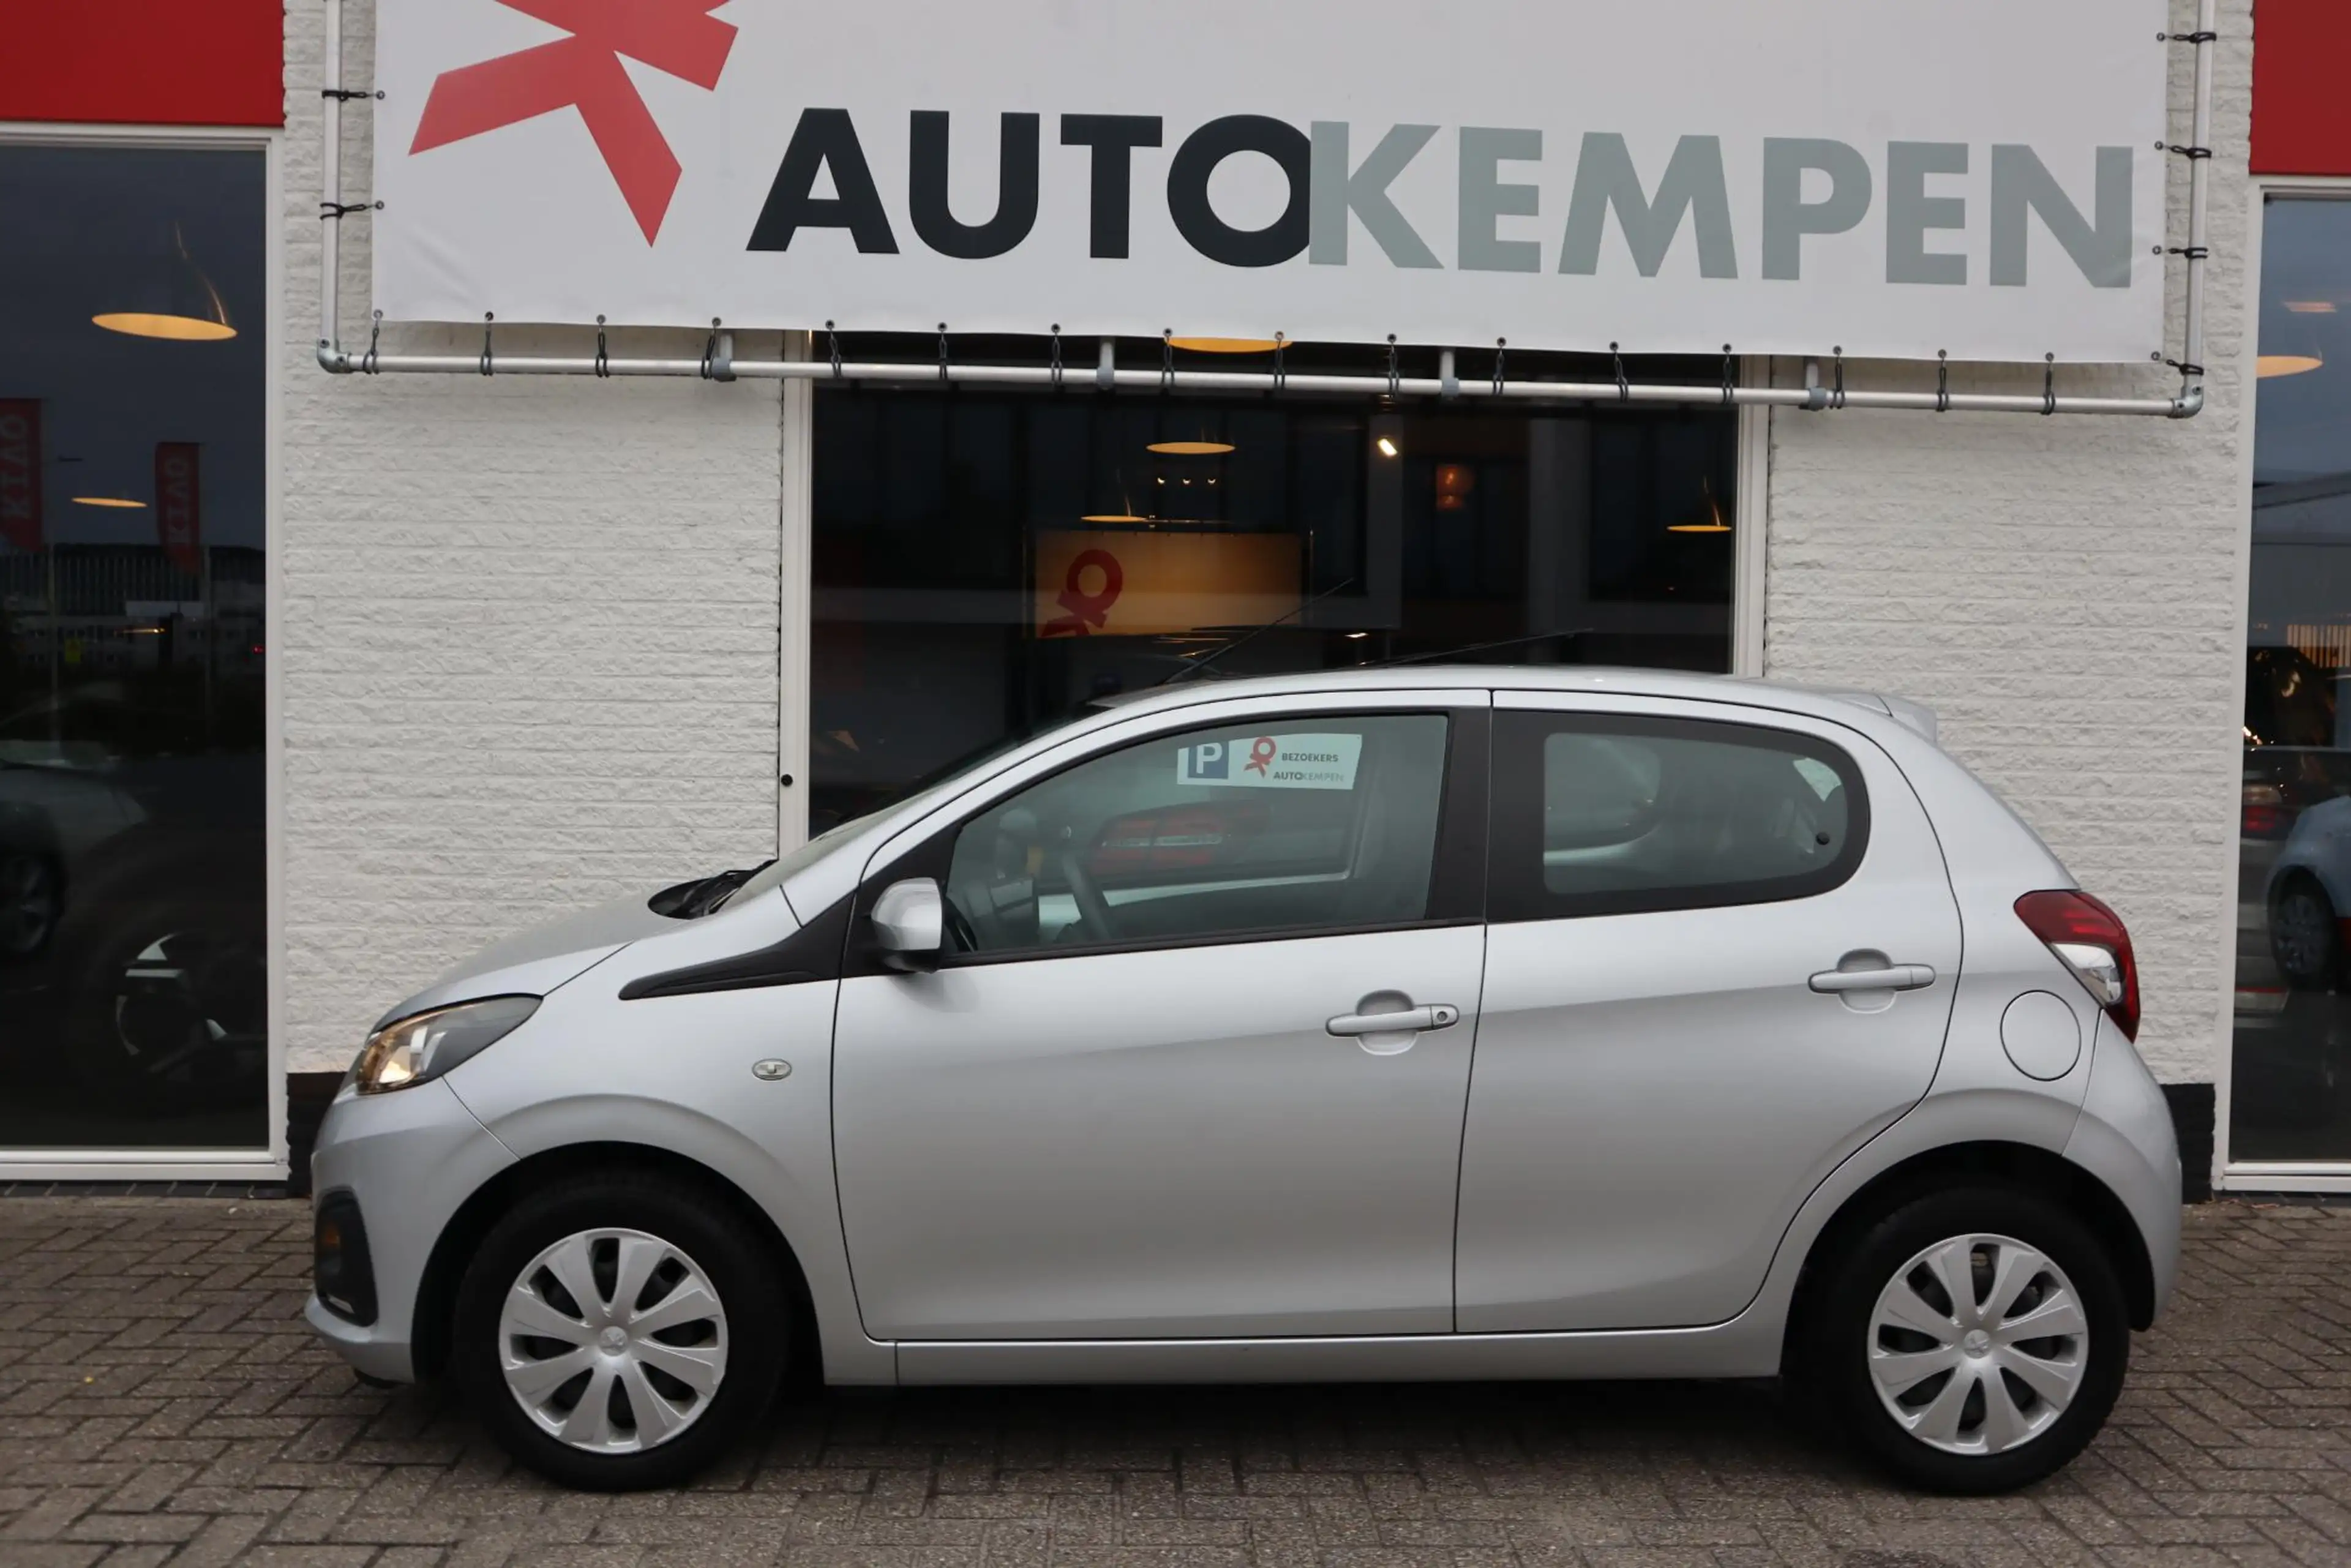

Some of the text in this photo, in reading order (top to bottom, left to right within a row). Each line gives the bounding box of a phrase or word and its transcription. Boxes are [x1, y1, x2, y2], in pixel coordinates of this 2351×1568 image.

[746, 108, 2134, 288] AUTOKEMPEN
[1196, 741, 1223, 774] P
[1281, 752, 1339, 762] BEZOEKERS
[1273, 771, 1344, 782] AUTOKEMPEN
